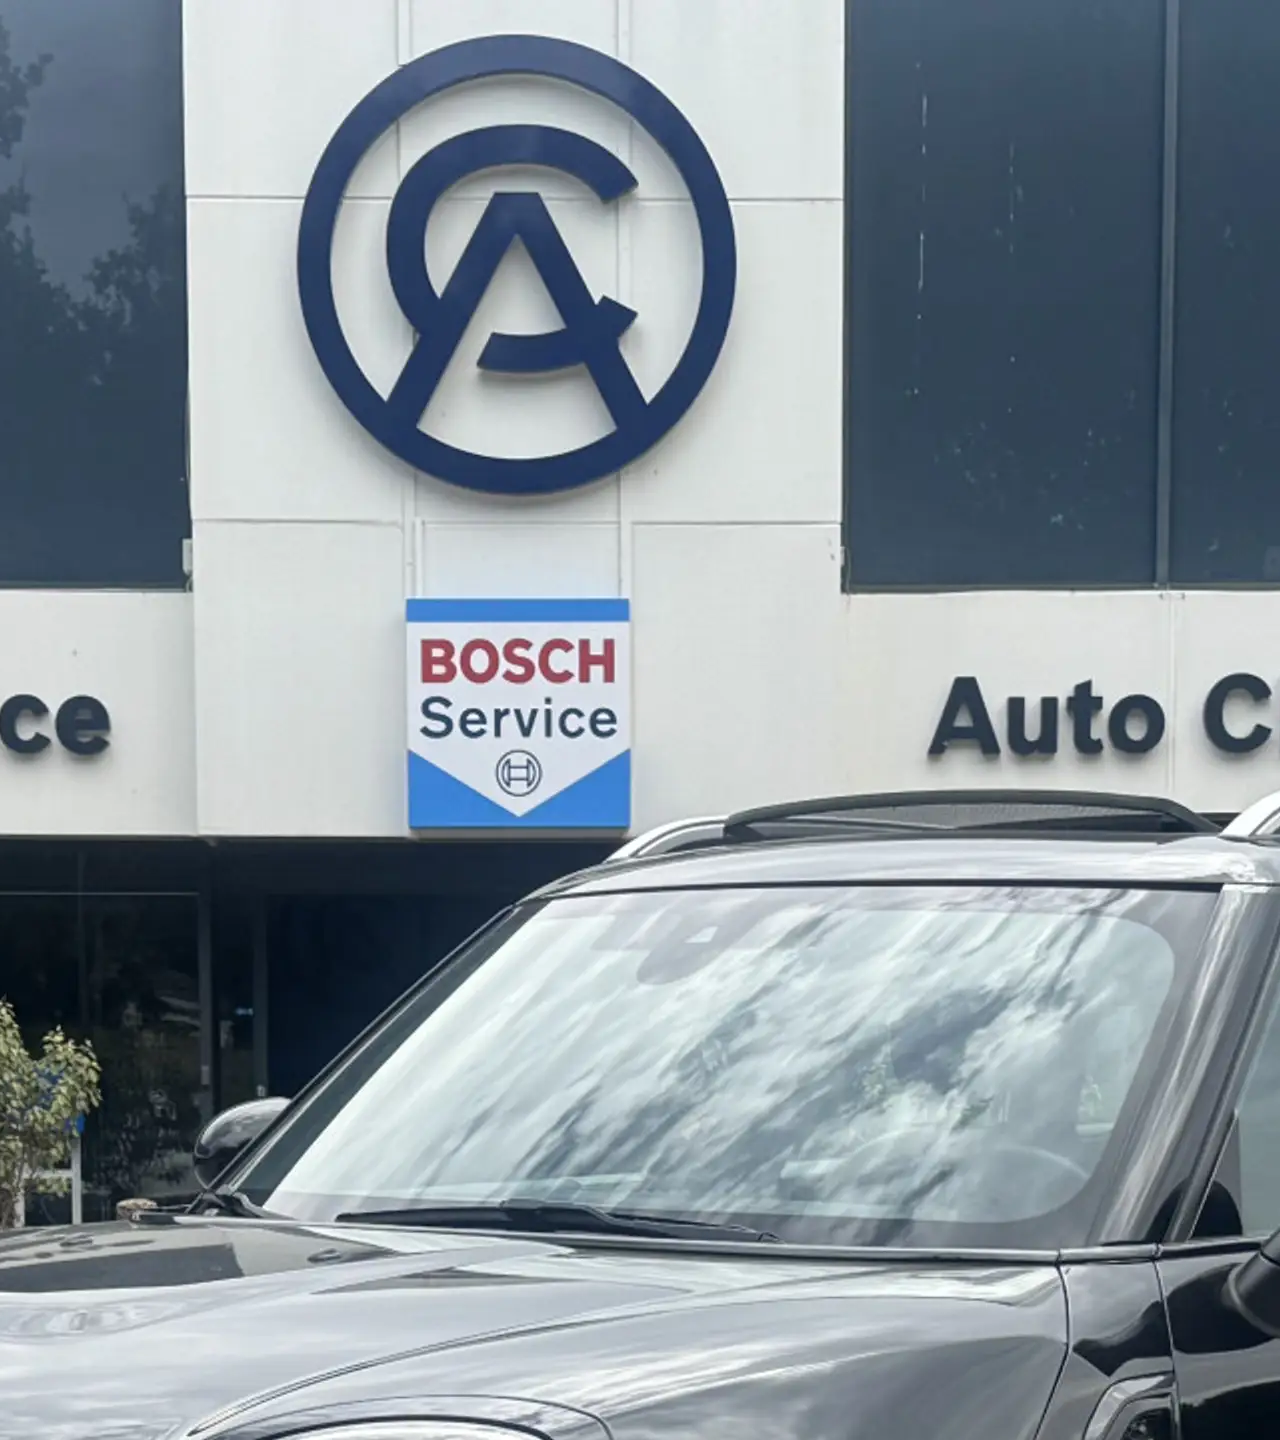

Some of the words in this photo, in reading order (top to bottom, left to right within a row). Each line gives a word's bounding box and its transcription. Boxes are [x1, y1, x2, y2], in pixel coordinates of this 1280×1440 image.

[420, 638, 615, 684] BOSCH
[420, 696, 618, 739] Service
[928, 674, 1166, 759] Auto
